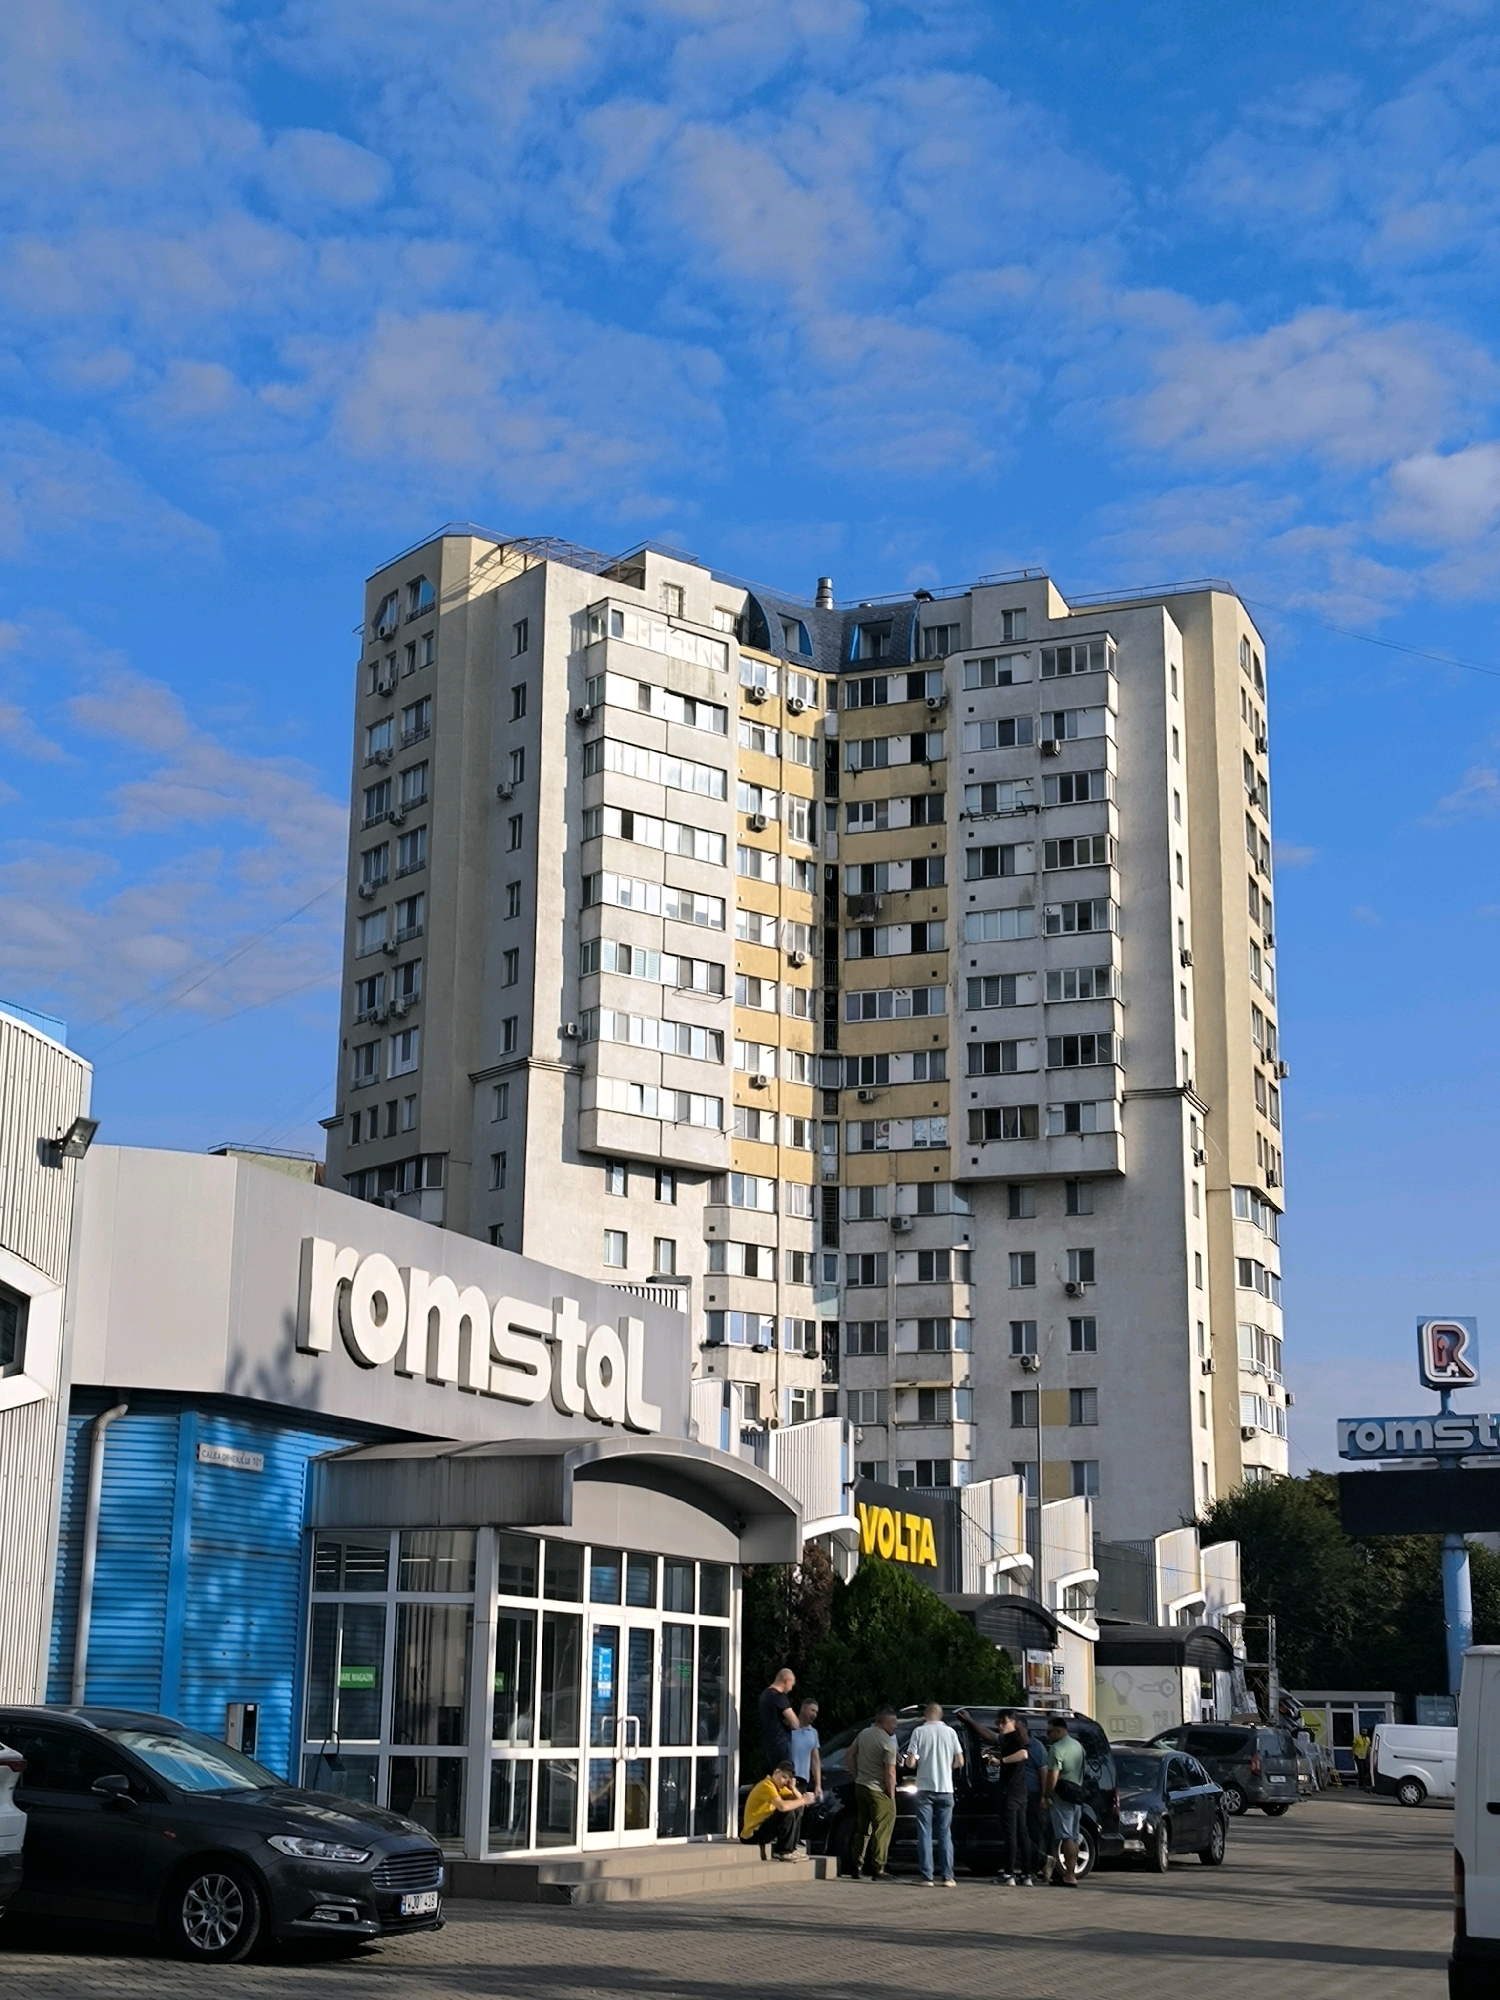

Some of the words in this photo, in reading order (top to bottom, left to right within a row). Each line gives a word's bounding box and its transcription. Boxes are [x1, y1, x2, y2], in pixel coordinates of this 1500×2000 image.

[297, 1237, 662, 1434] romstal
[1337, 1413, 1500, 1452] romst
[857, 1502, 938, 1567] VOLTA
[351, 1673, 374, 1682] MAGAZIN
